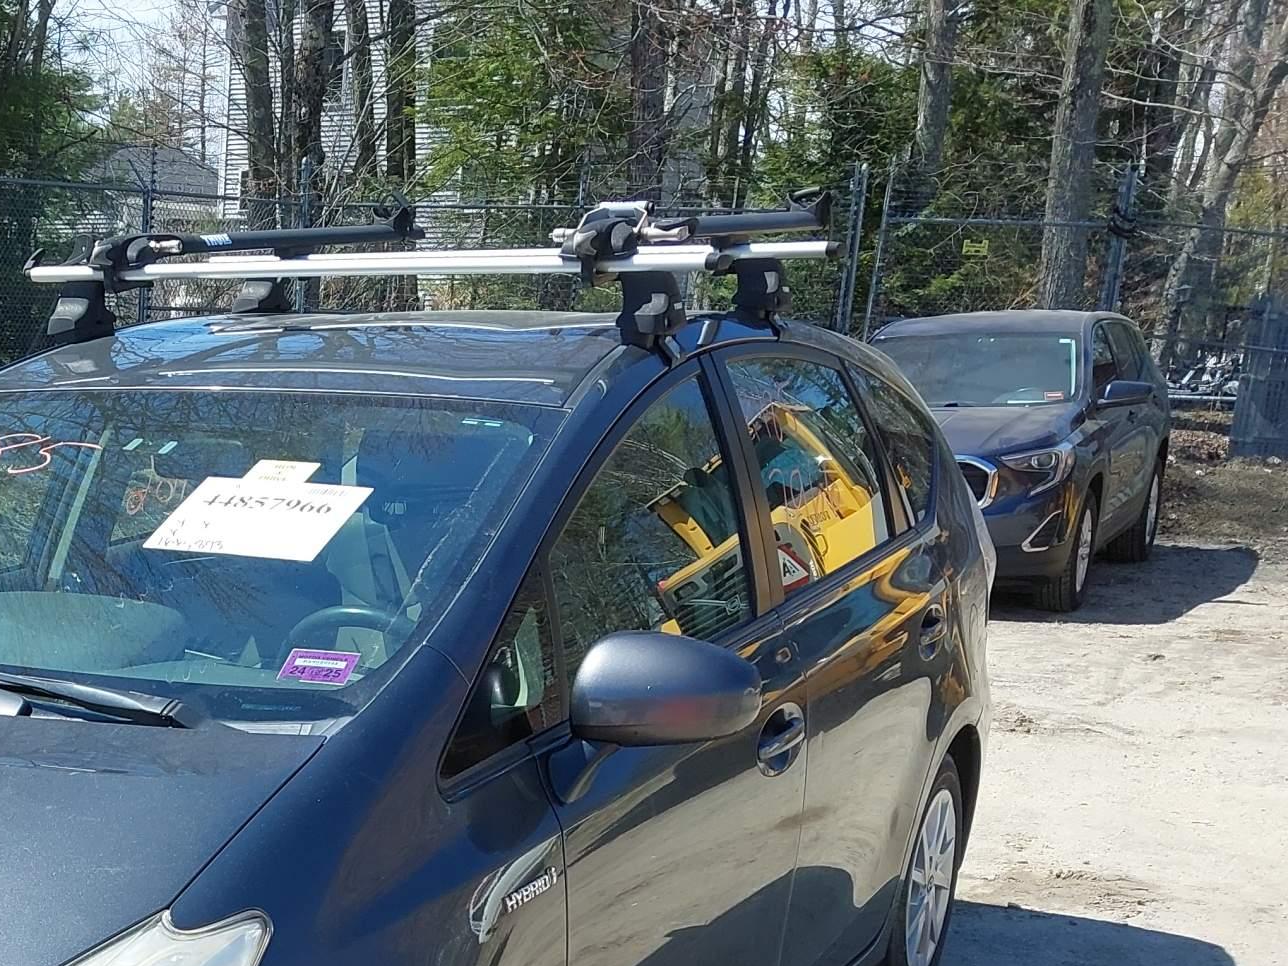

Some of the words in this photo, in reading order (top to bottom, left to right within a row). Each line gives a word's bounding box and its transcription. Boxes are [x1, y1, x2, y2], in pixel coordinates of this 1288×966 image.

[202, 494, 332, 515] 44857966
[289, 666, 306, 676] 24
[323, 668, 343, 679] 25
[504, 875, 551, 913] HYBRID
